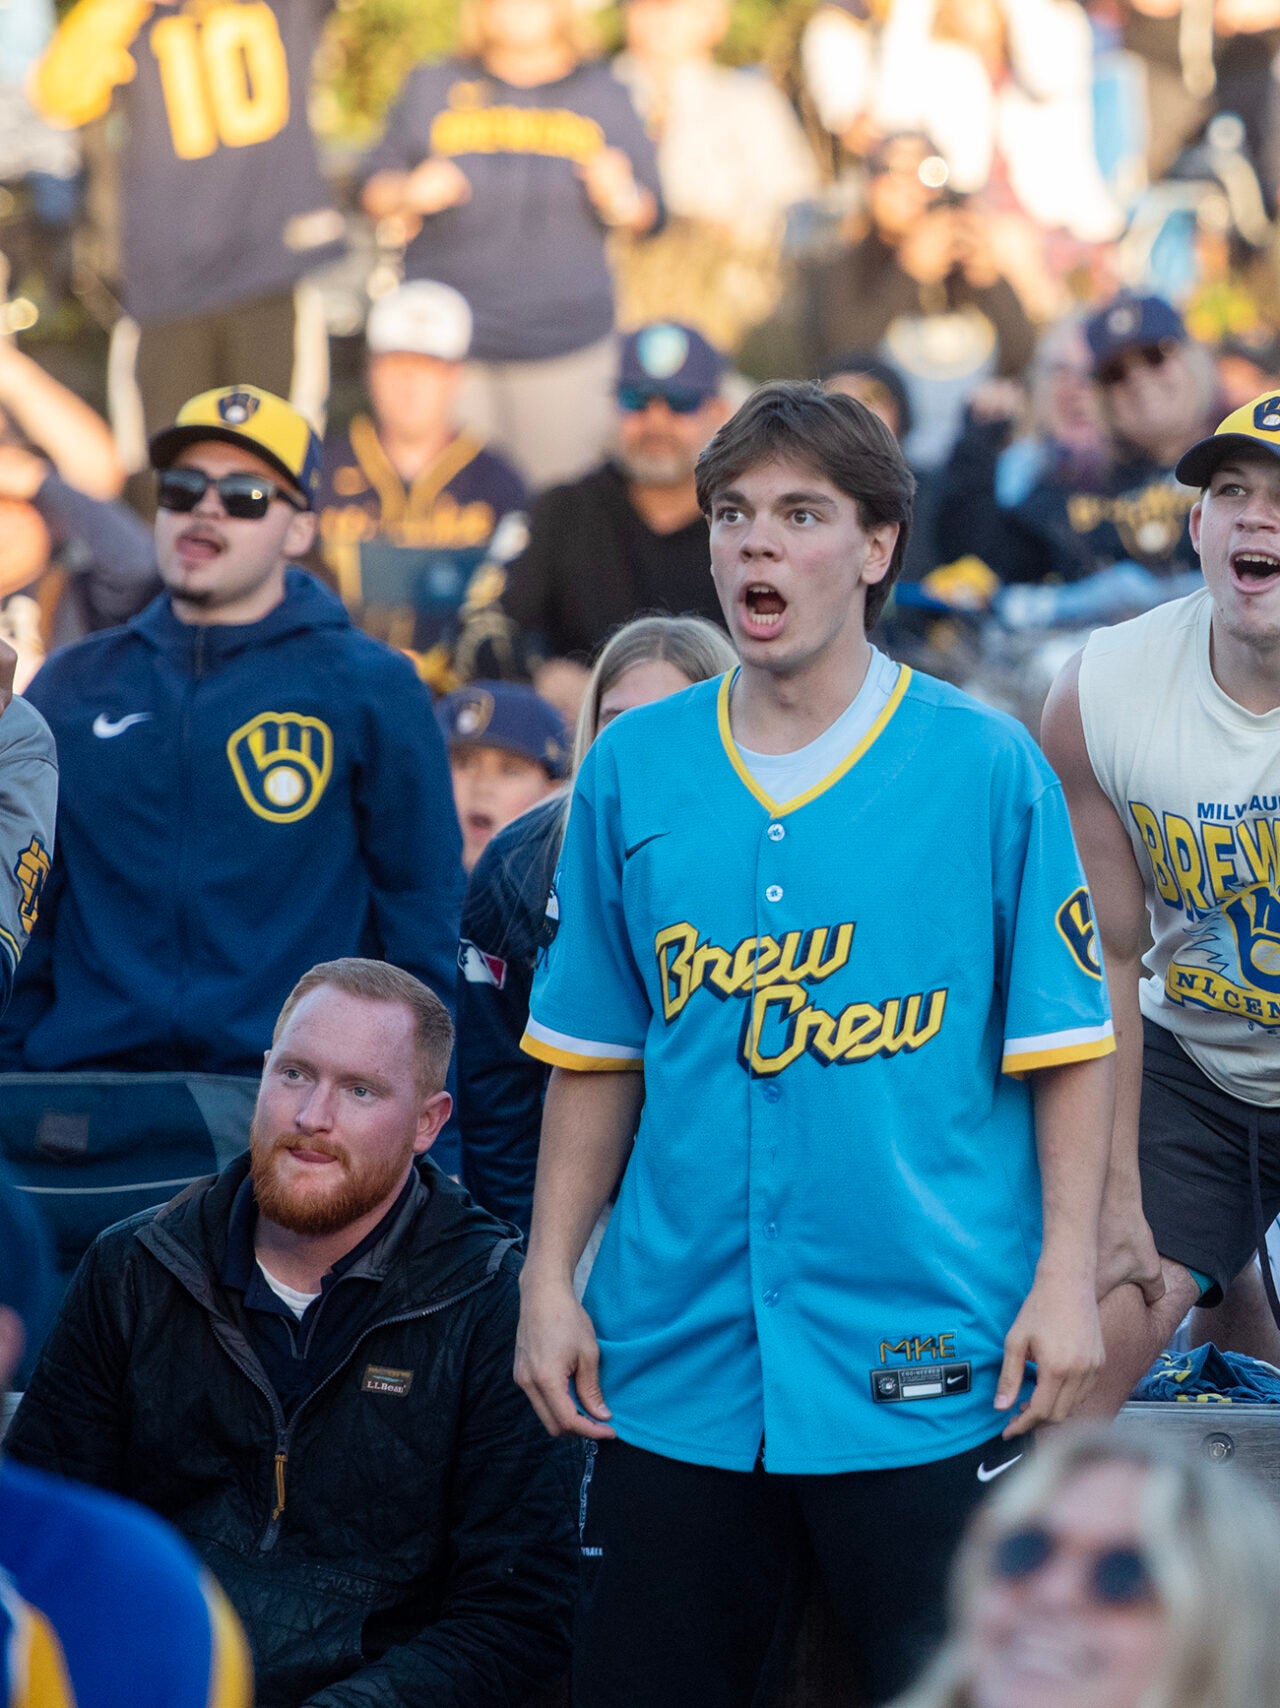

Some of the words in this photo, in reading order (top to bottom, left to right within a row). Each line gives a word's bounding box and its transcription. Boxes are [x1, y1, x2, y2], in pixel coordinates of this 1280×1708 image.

[150, 3, 290, 161] 10
[655, 920, 857, 1027] Brew
[736, 987, 949, 1080] Crew
[879, 1333, 956, 1364] MKE
